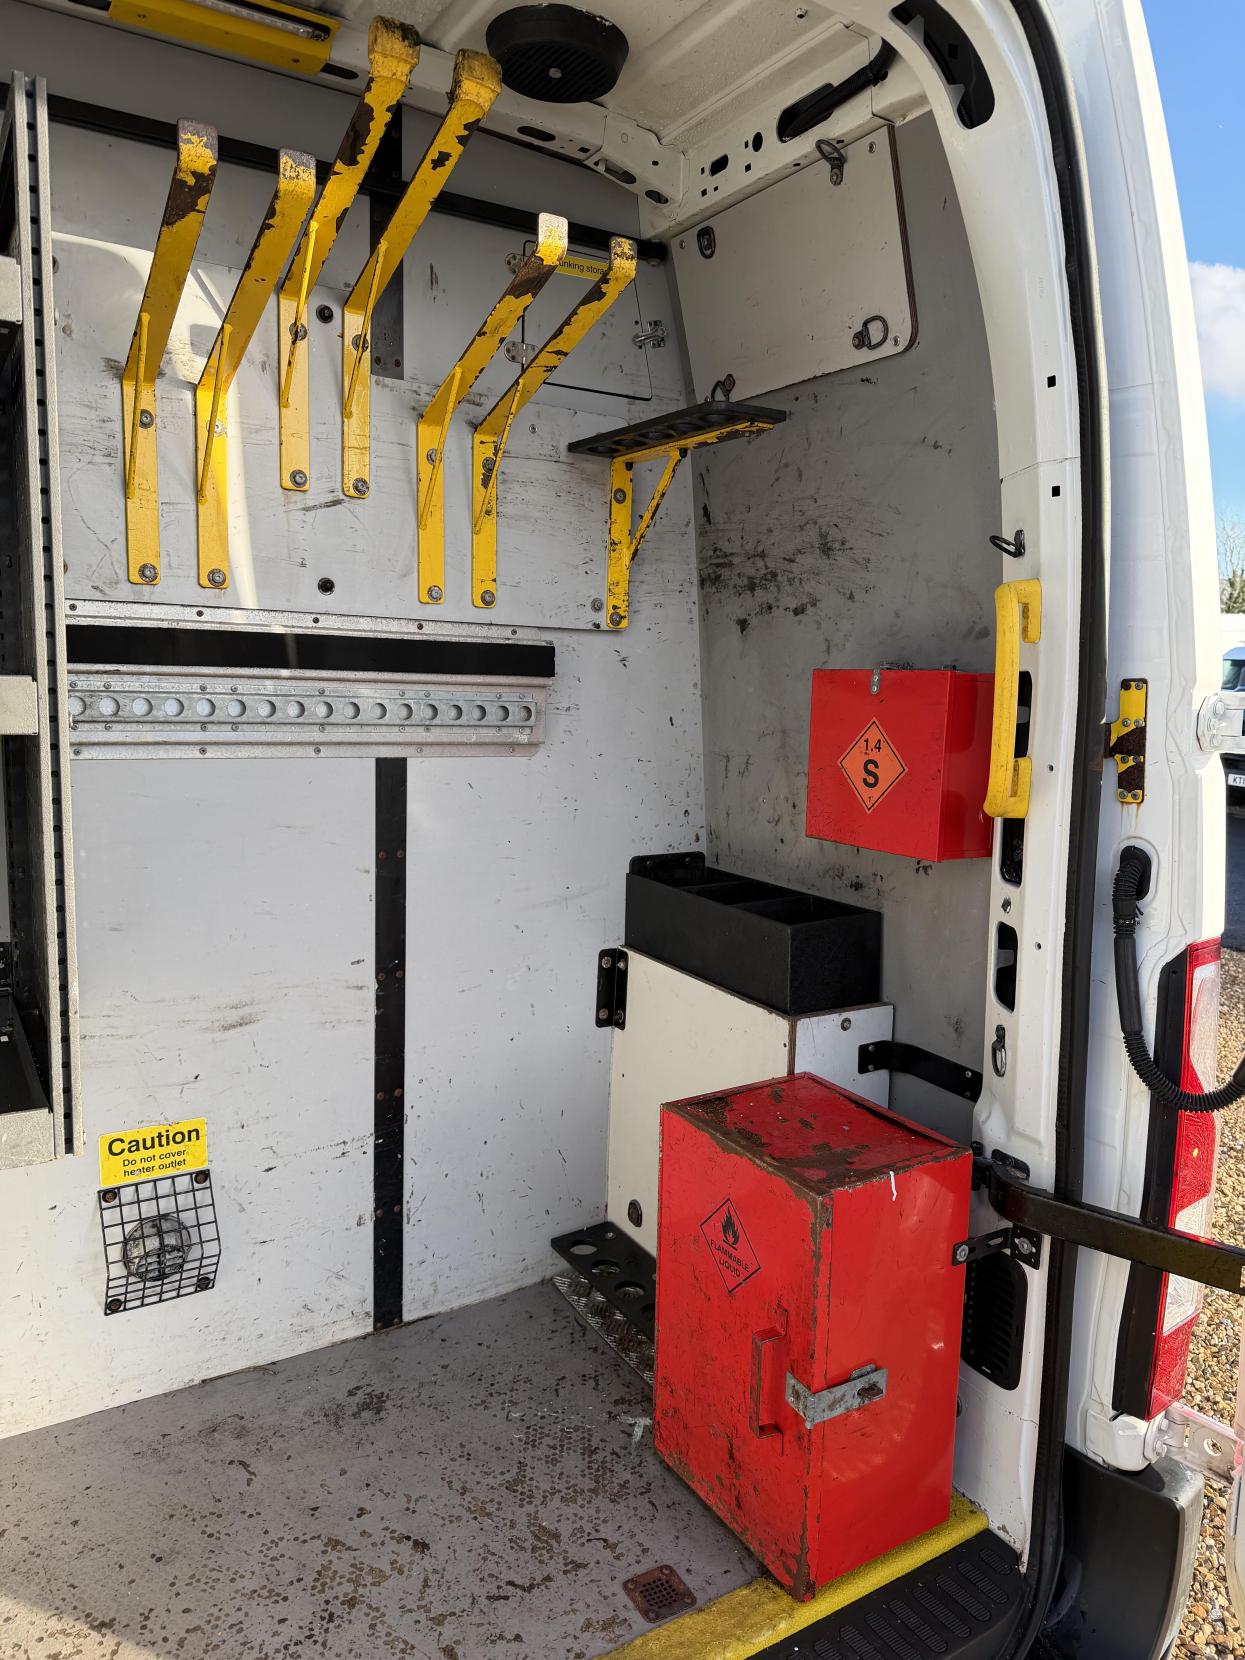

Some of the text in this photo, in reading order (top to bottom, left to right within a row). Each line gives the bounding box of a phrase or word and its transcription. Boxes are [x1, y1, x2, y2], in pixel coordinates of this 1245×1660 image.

[560, 260, 584, 272] unking
[864, 737, 882, 752] 1.4
[863, 759, 879, 788] S
[108, 1128, 200, 1156] Caution
[122, 1149, 187, 1167] Do not cover
[123, 1158, 186, 1177] heater outlet
[710, 1238, 750, 1272] FLAMMABLE
[718, 1258, 741, 1277] LIQUID
